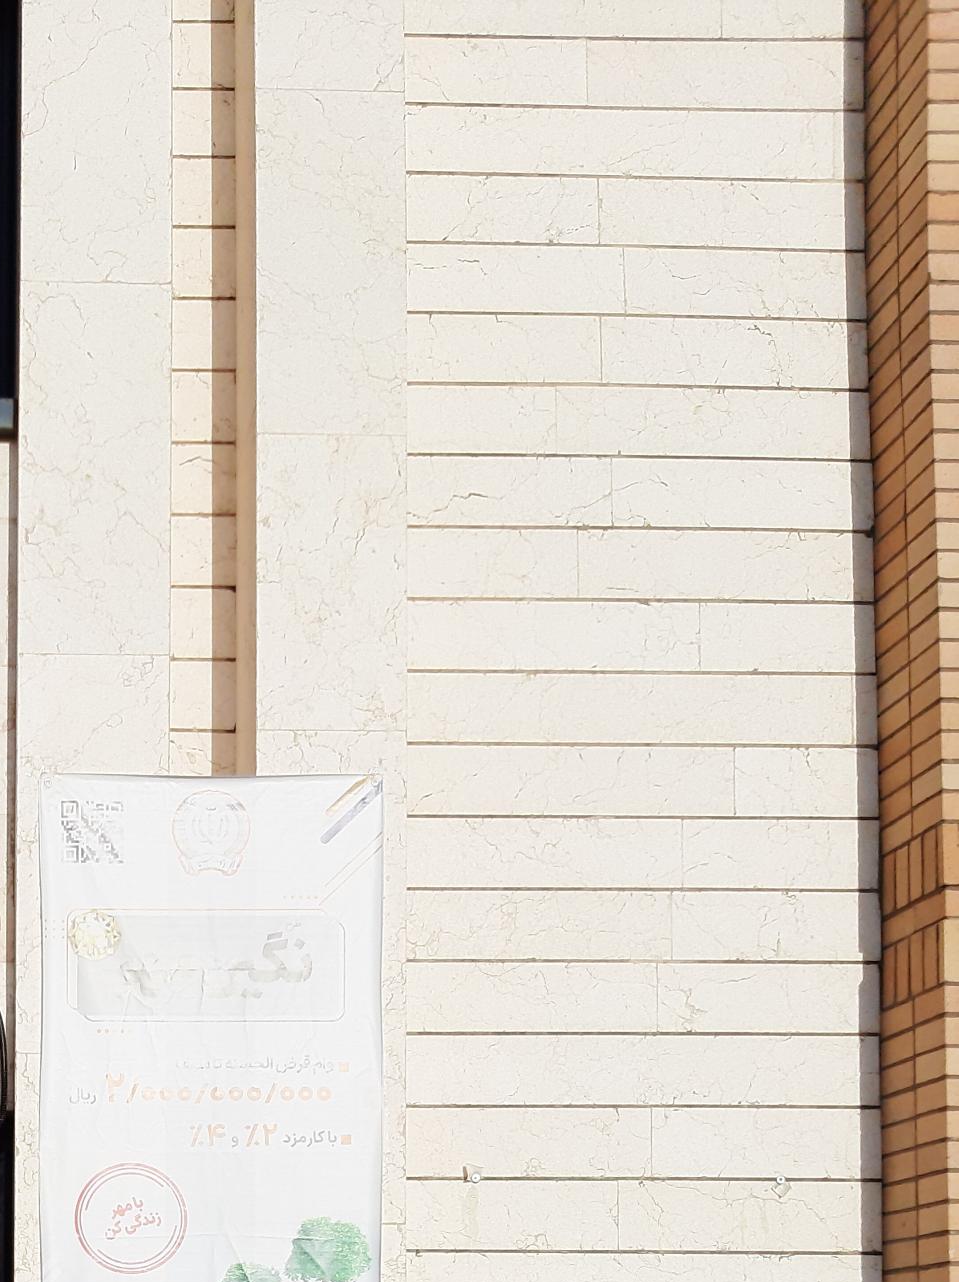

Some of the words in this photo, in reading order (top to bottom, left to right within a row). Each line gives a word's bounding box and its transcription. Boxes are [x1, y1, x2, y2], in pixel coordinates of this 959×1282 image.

[275, 1054, 311, 1075] قرض
[69, 1086, 97, 1105] ریال
[230, 1135, 240, 1149] و
[282, 1130, 326, 1148] کارمزد
[111, 1202, 133, 1220] مهر
[132, 1196, 144, 1212] با
[104, 1219, 123, 1240] کن
[124, 1213, 162, 1235] زندگی
